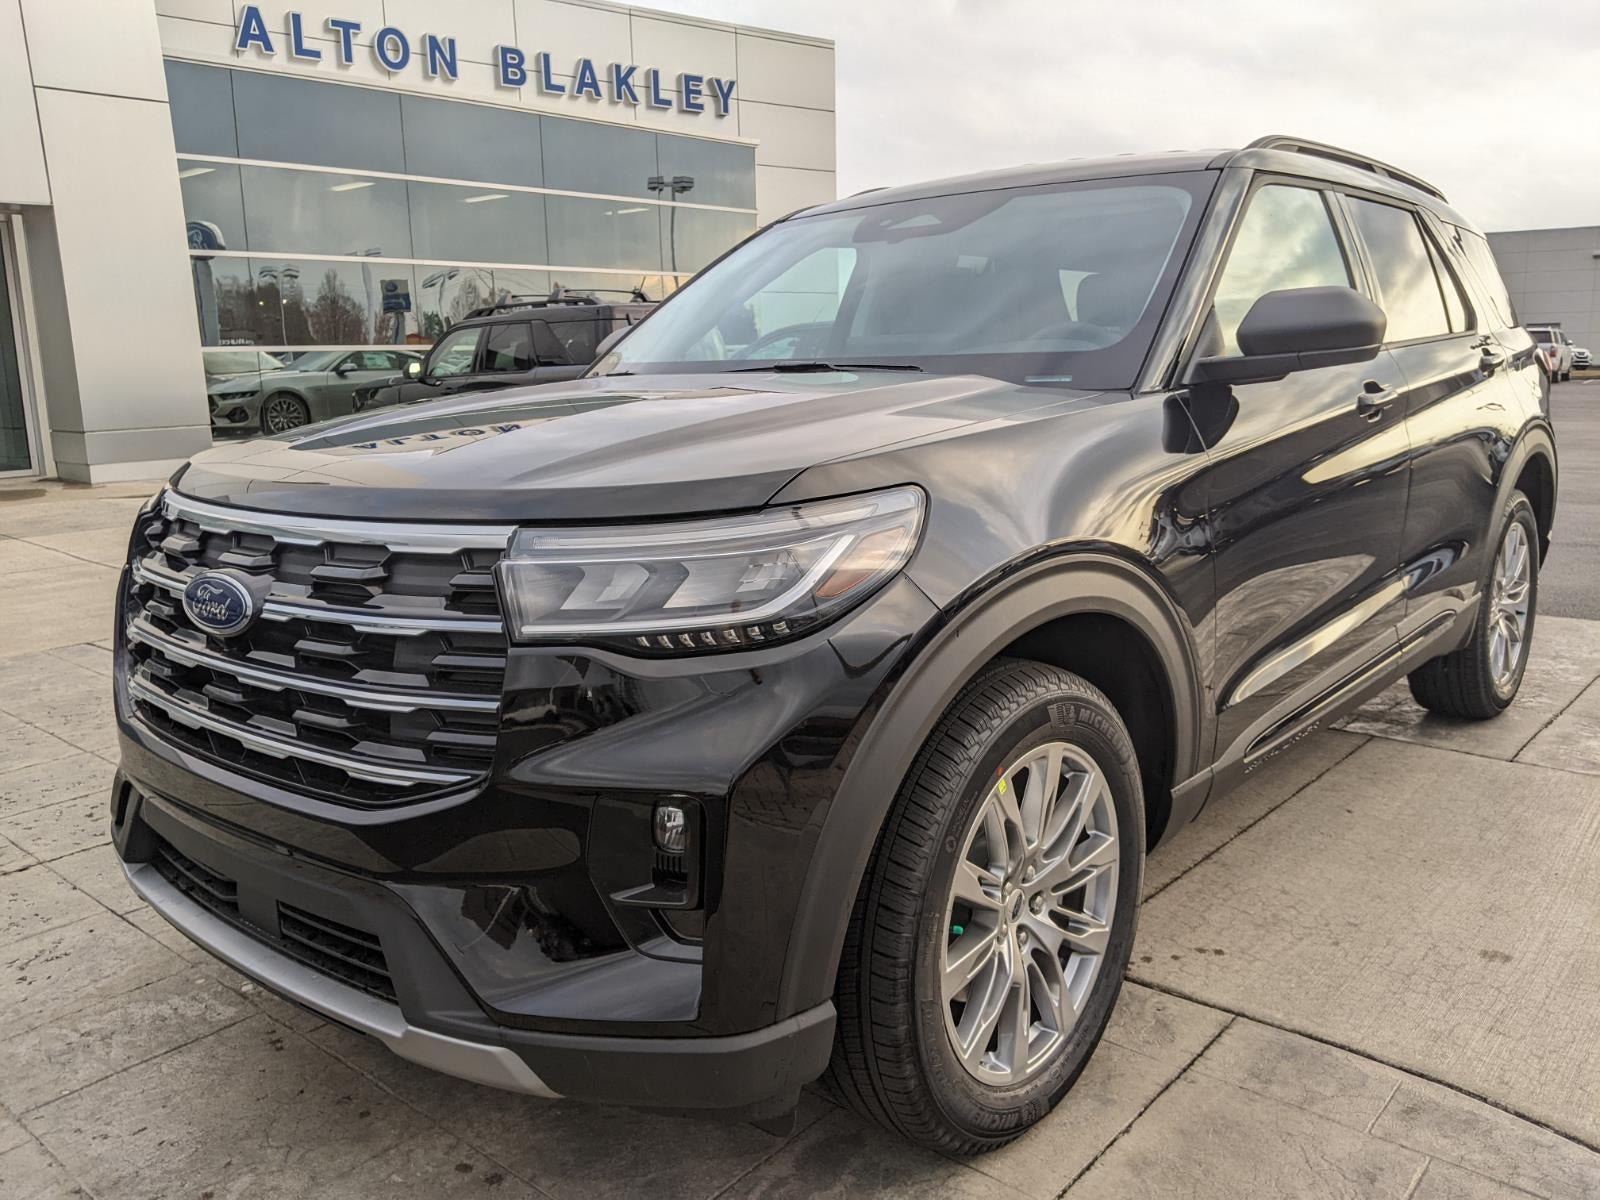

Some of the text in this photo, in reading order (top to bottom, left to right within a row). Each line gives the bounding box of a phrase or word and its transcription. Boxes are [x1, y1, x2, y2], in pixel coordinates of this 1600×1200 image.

[235, 4, 736, 116] ALTON BLAKLEY
[193, 584, 231, 620] Ford
